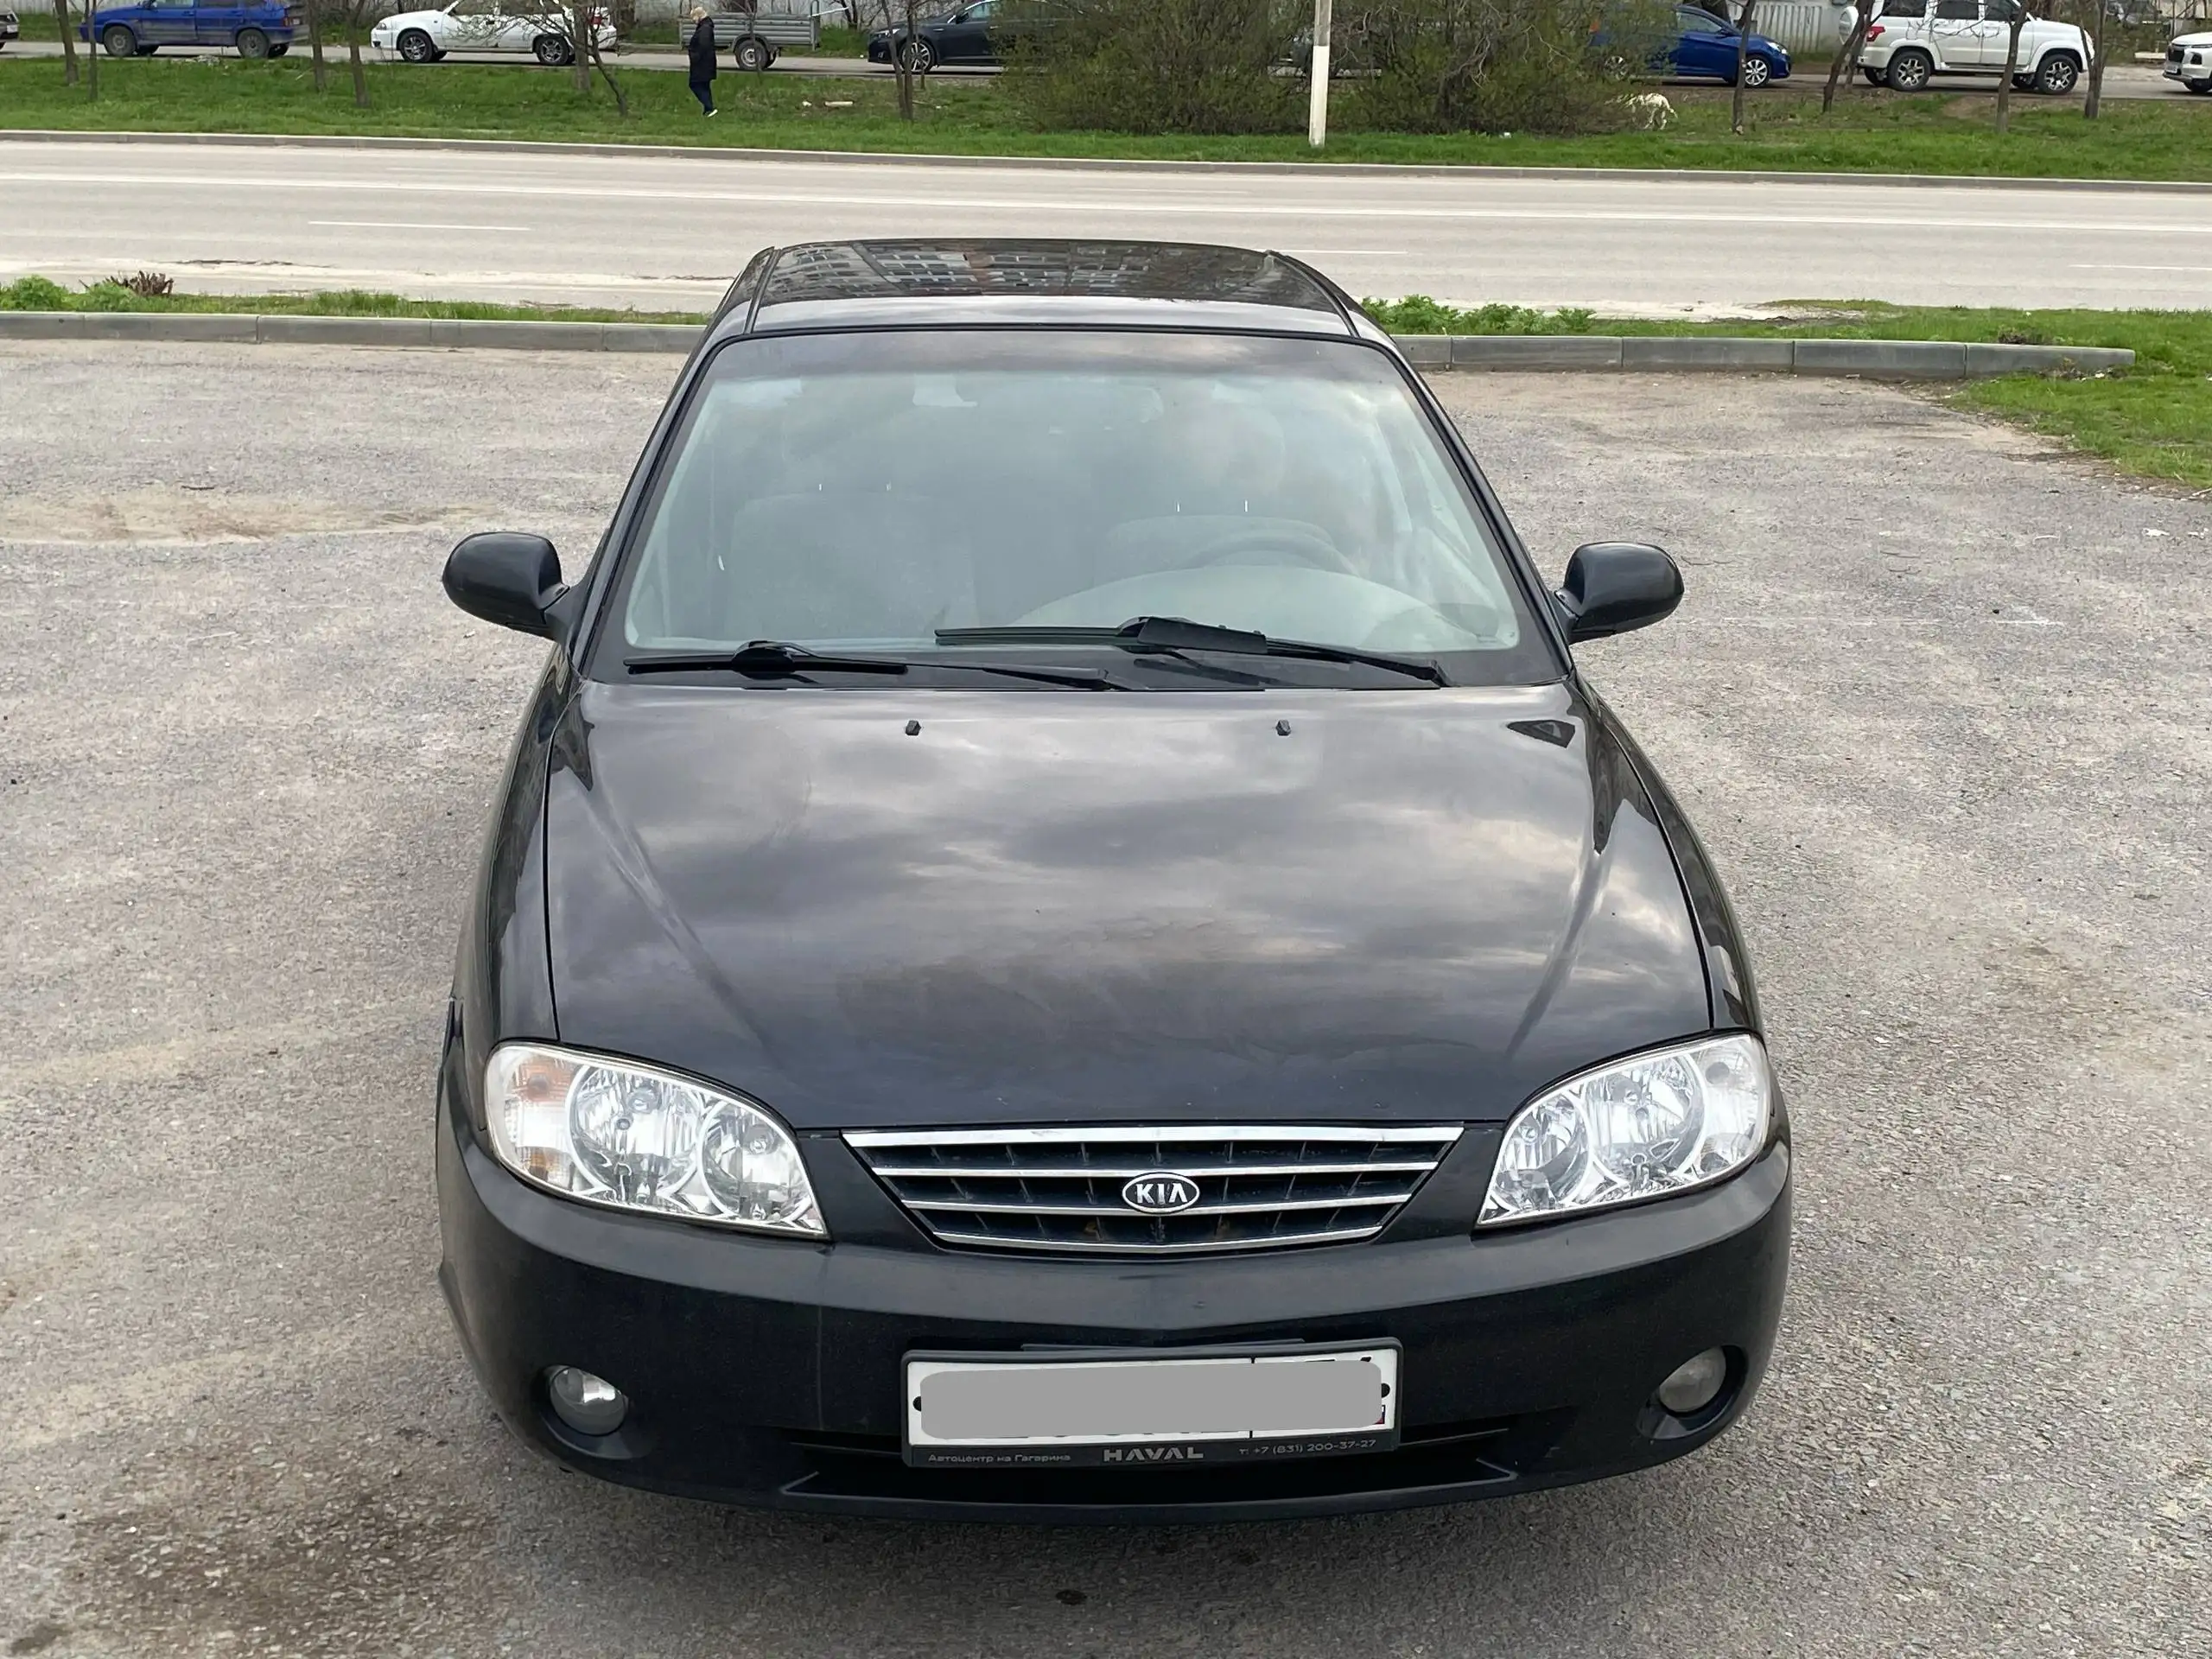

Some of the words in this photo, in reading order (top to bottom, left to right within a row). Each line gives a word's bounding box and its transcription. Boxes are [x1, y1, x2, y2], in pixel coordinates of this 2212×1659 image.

[1135, 1183, 1188, 1205] KIA
[1103, 1446, 1204, 1462] HAVAL
[1273, 1444, 1303, 1455] (831)
[1306, 1439, 1376, 1452] 200-37-27
[928, 1454, 994, 1464] Автоцентр
[1014, 1453, 1071, 1463] Гагарина
